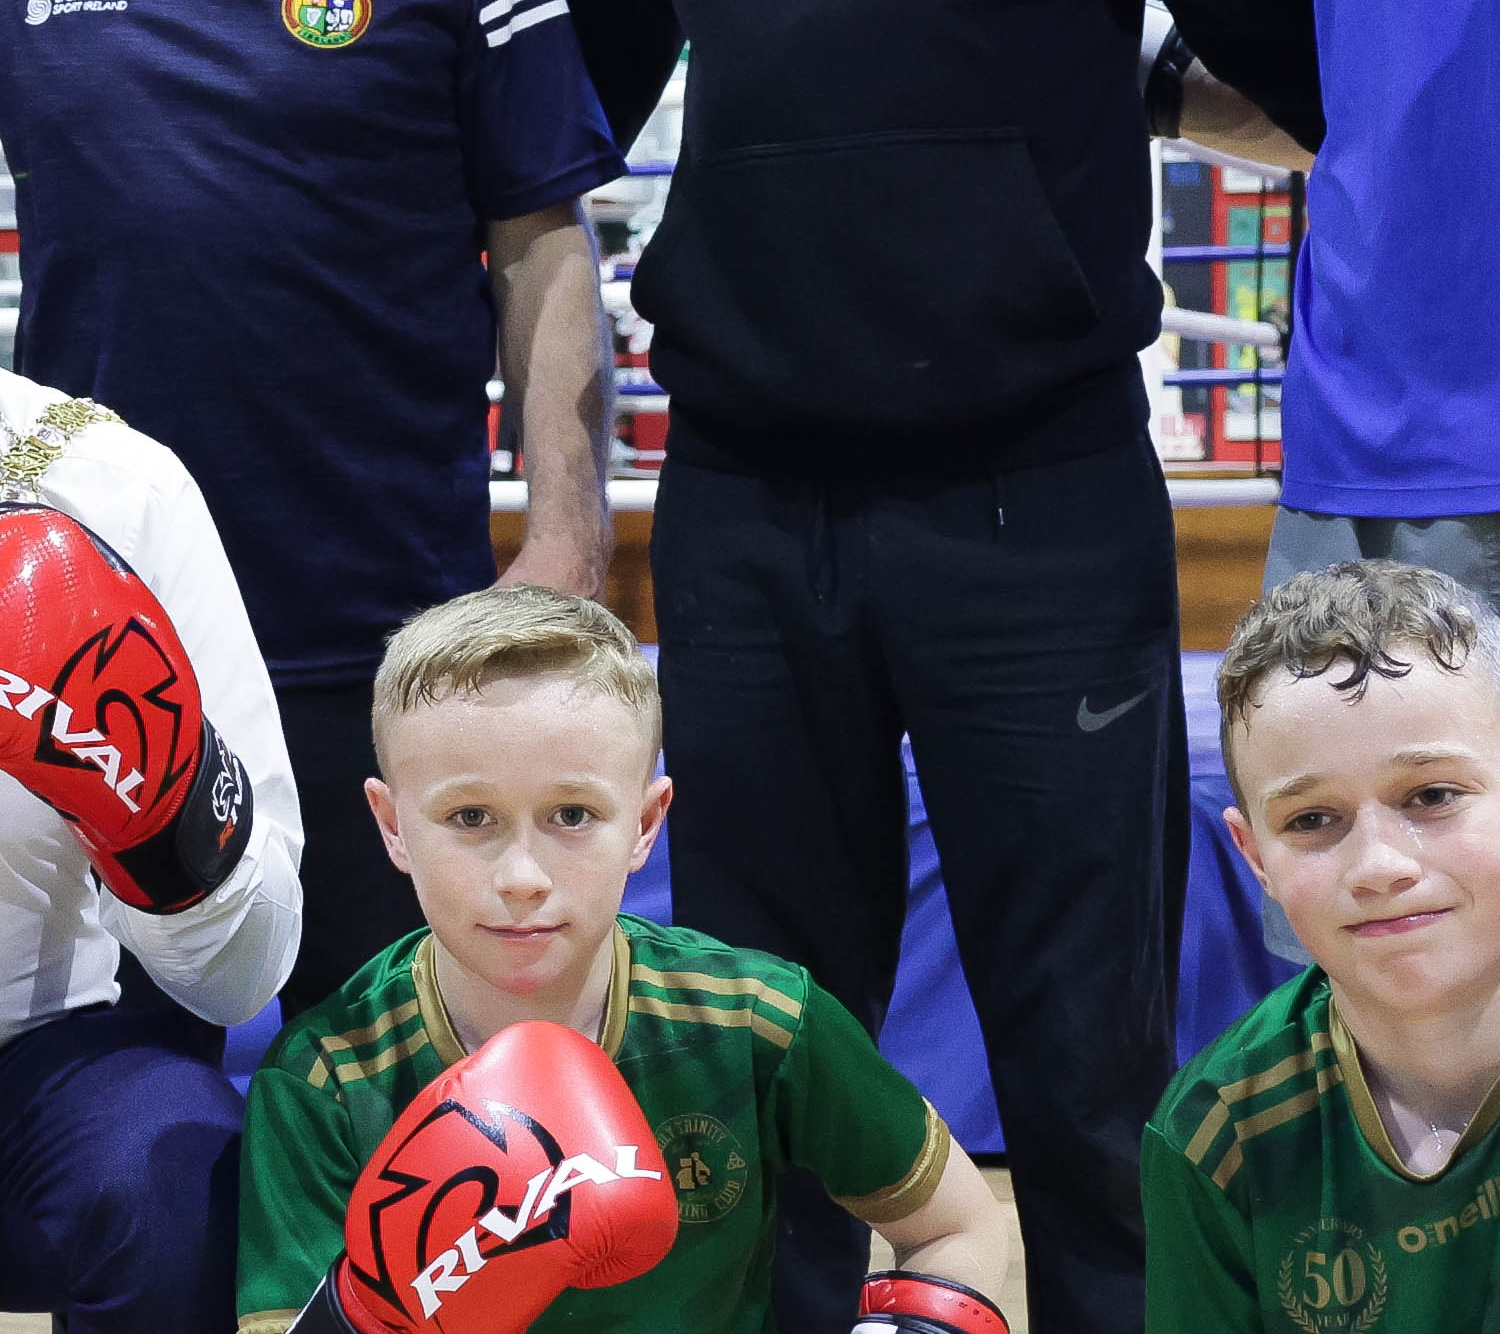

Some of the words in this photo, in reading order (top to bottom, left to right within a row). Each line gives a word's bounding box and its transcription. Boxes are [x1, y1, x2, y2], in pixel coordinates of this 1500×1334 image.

[53, 2, 83, 16] SPORT
[83, 0, 129, 13] IRELAND
[411, 1144, 663, 1319] RIVAL
[1302, 1247, 1367, 1310] 50
